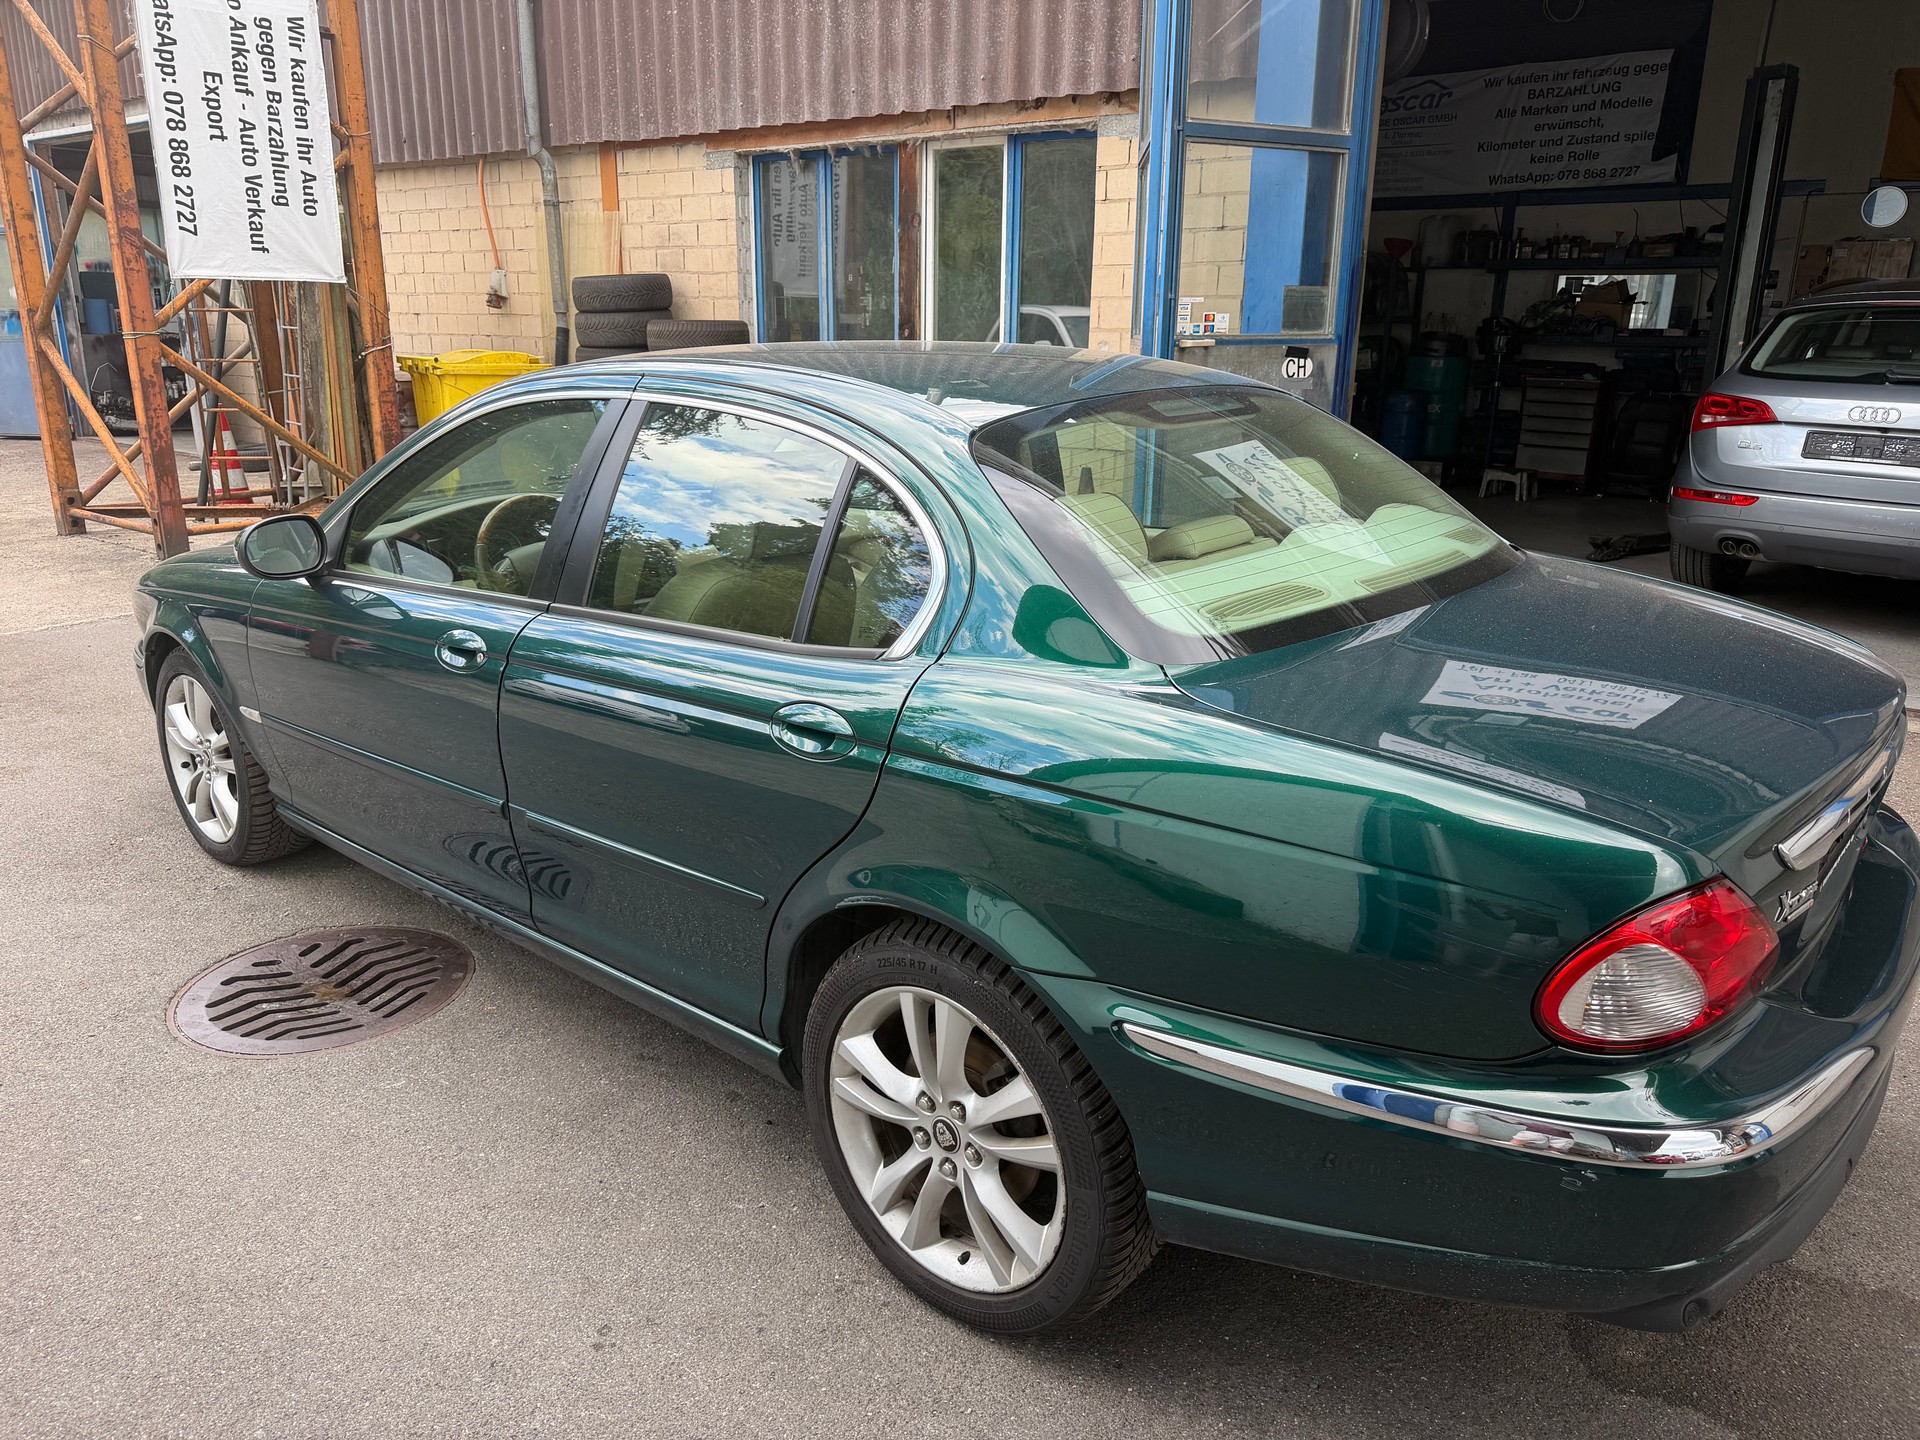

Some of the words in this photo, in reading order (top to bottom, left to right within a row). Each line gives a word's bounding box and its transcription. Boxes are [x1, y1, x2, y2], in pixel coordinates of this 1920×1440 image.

[287, 17, 305, 52] Wir
[230, 16, 256, 96] Ankauf
[1484, 77, 1503, 88] Wir
[1507, 72, 1548, 87] kaufen
[1553, 70, 1569, 83] ihr
[1573, 65, 1629, 81] fahrzeug
[1528, 81, 1622, 100] BARZAHLUNG
[201, 72, 227, 141] Export
[291, 58, 309, 129] kaufen
[1495, 108, 1517, 119] Alle
[1521, 104, 1568, 117] Marken
[1572, 101, 1596, 112] und
[1600, 96, 1653, 110] Modelle
[163, 92, 186, 131] 078
[254, 17, 276, 82] gegen
[267, 90, 289, 206] Barzahlung
[1393, 116, 1425, 126] OSCAR
[1428, 113, 1457, 123] GMBH
[1534, 117, 1604, 132] erwünscht,
[169, 138, 191, 177] 868
[239, 118, 259, 166] Auto
[297, 137, 313, 164] ihr
[1477, 139, 1536, 153] Kilometer
[1539, 136, 1563, 147] und
[1567, 132, 1620, 146] Zustand
[1530, 152, 1564, 164] keine
[1568, 150, 1599, 162] Rolle
[1558, 169, 1580, 180] 078
[1584, 168, 1606, 179] 868
[1609, 166, 1641, 177] 2727
[301, 170, 318, 216] Auto
[174, 185, 197, 236] 2727
[245, 175, 269, 253] Verkauf
[1286, 357, 1307, 378] CH
[877, 958, 907, 969] 225/45
[930, 964, 938, 975] H
